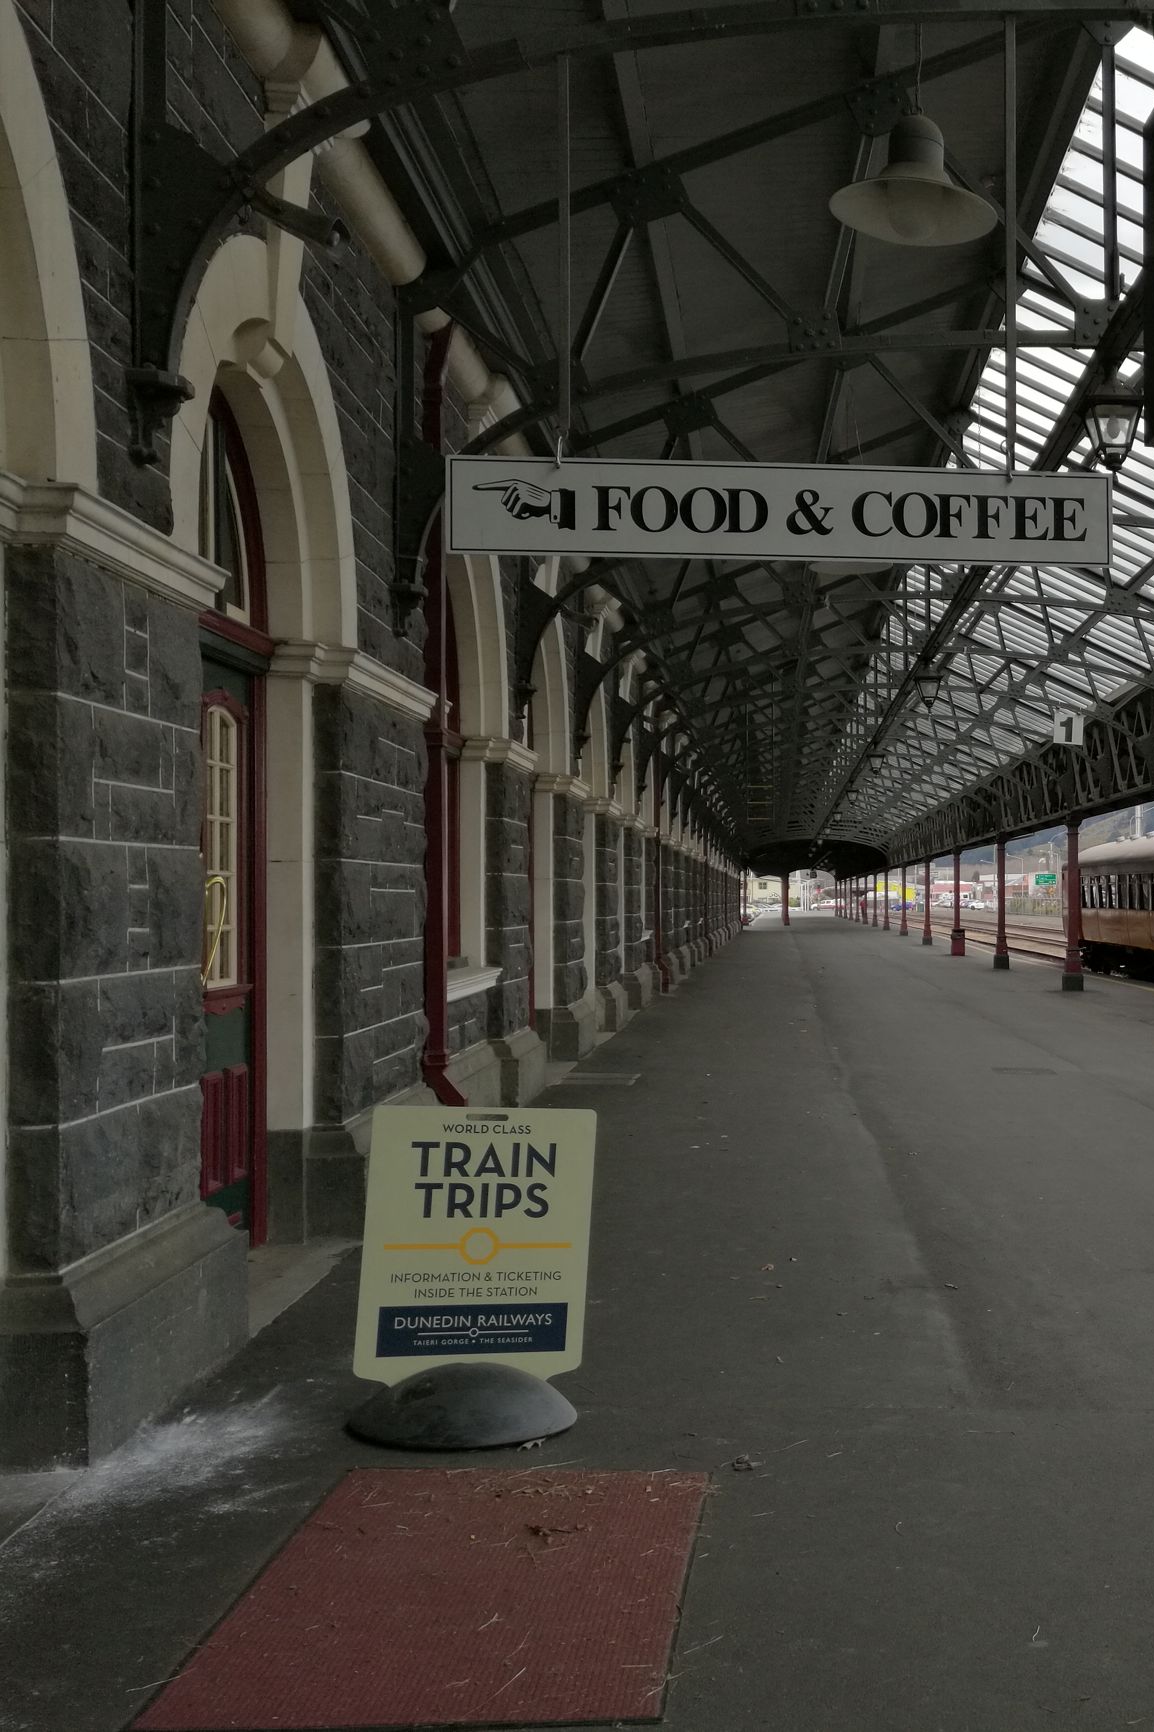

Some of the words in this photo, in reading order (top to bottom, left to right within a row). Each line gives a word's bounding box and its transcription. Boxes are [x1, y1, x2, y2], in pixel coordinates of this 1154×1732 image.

[591, 485, 769, 533] FOOD
[786, 489, 834, 536] &
[851, 491, 1088, 543] COFFEE
[1060, 716, 1073, 743] 1
[443, 1123, 489, 1135] WORLD
[492, 1123, 532, 1135] CLASS
[411, 1141, 557, 1178] TRAIN
[414, 1182, 549, 1219] TRIPS
[390, 1272, 481, 1284] INFORMATION
[483, 1271, 493, 1283] &
[496, 1270, 562, 1282] TICKETING
[414, 1287, 455, 1299] INSIDE
[459, 1287, 483, 1298] THE
[486, 1286, 538, 1297] STATION
[394, 1315, 472, 1330] DUNEDIN
[477, 1313, 553, 1327] RAILWAYS
[413, 1339, 439, 1347] TAIERI
[441, 1338, 469, 1346] GORGE
[479, 1337, 496, 1345] THE
[497, 1336, 533, 1345] SEASIDER
